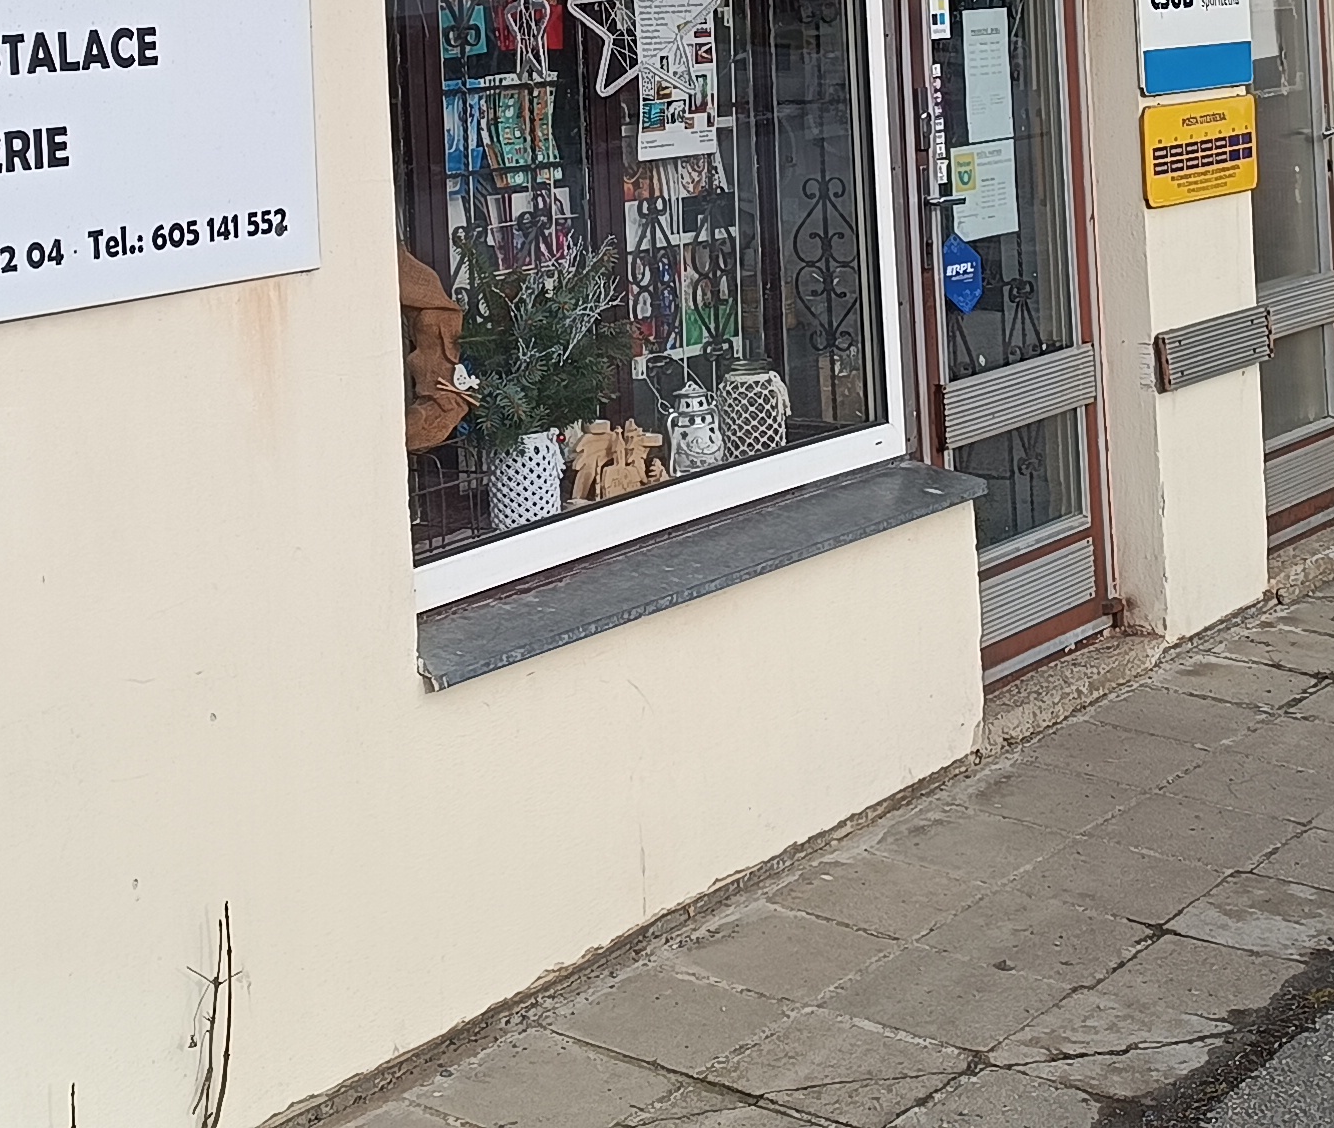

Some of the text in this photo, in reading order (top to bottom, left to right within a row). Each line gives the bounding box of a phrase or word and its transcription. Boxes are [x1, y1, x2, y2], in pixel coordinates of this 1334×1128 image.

[27, 238, 65, 270] 04
[87, 225, 144, 261] Tel.:
[151, 219, 200, 251] 605
[206, 213, 240, 243] 141
[246, 207, 289, 237] 552
